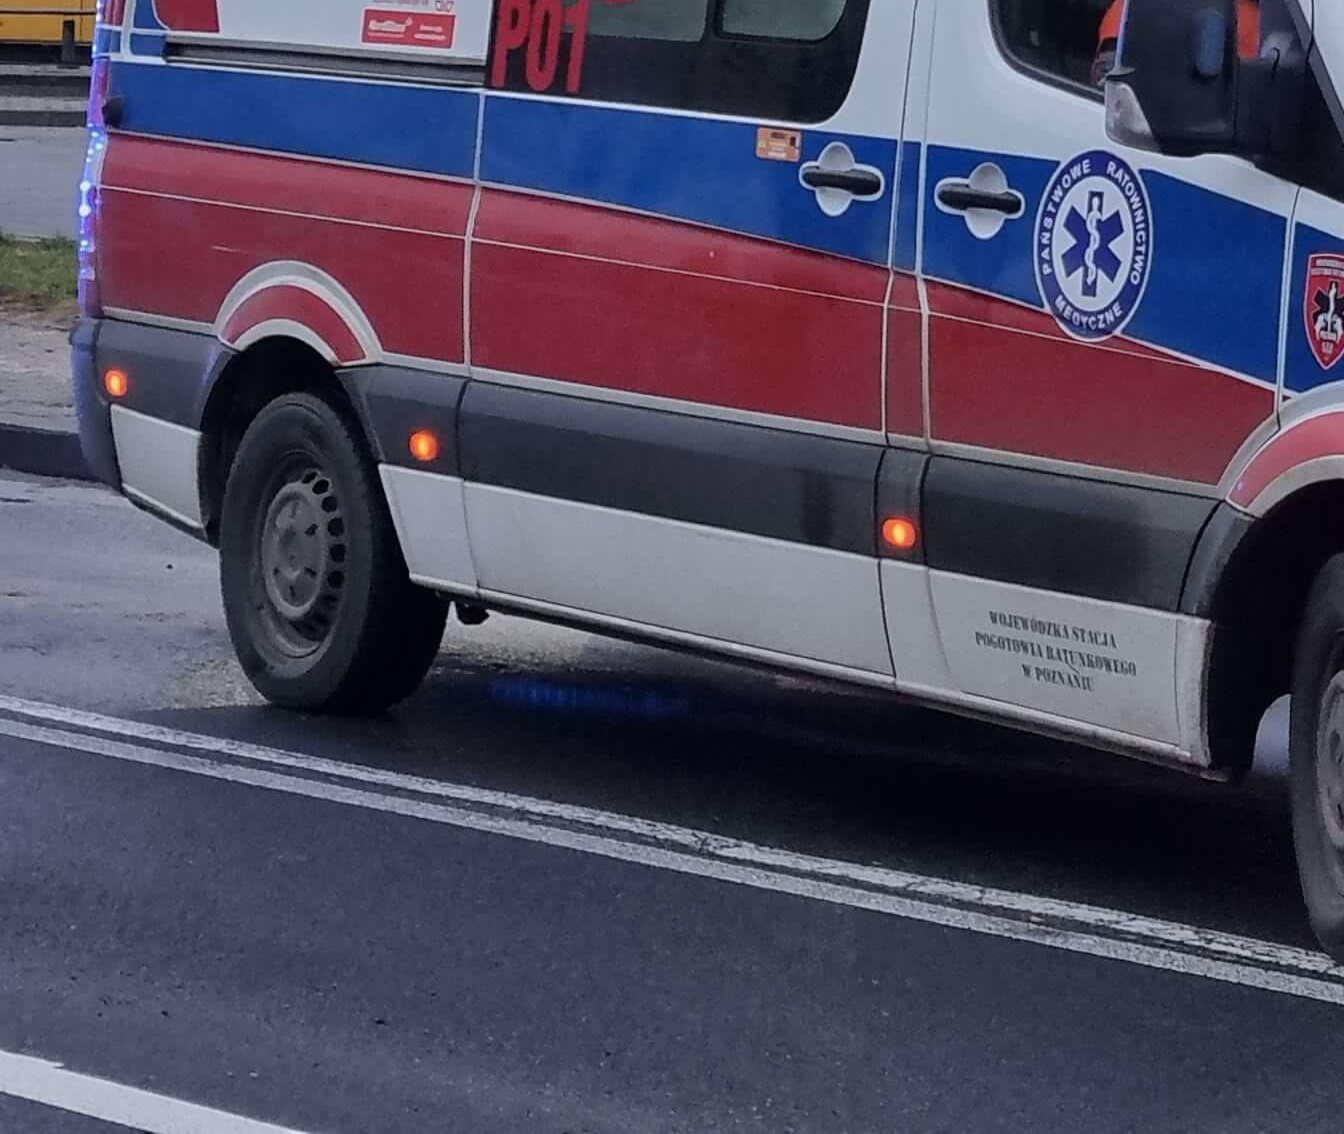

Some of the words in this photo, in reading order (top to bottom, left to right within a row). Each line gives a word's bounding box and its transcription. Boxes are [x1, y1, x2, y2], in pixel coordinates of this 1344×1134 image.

[1105, 160, 1146, 286] RATOWNICTWO
[1054, 293, 1124, 331] MEDYCZNE
[974, 631, 1044, 659] POGOTOWIA
[1046, 645, 1138, 677] RATUNKOWEGO
[1072, 627, 1118, 649] STACJA
[1022, 663, 1032, 678] W
[1035, 666, 1094, 692] POZNANIU
